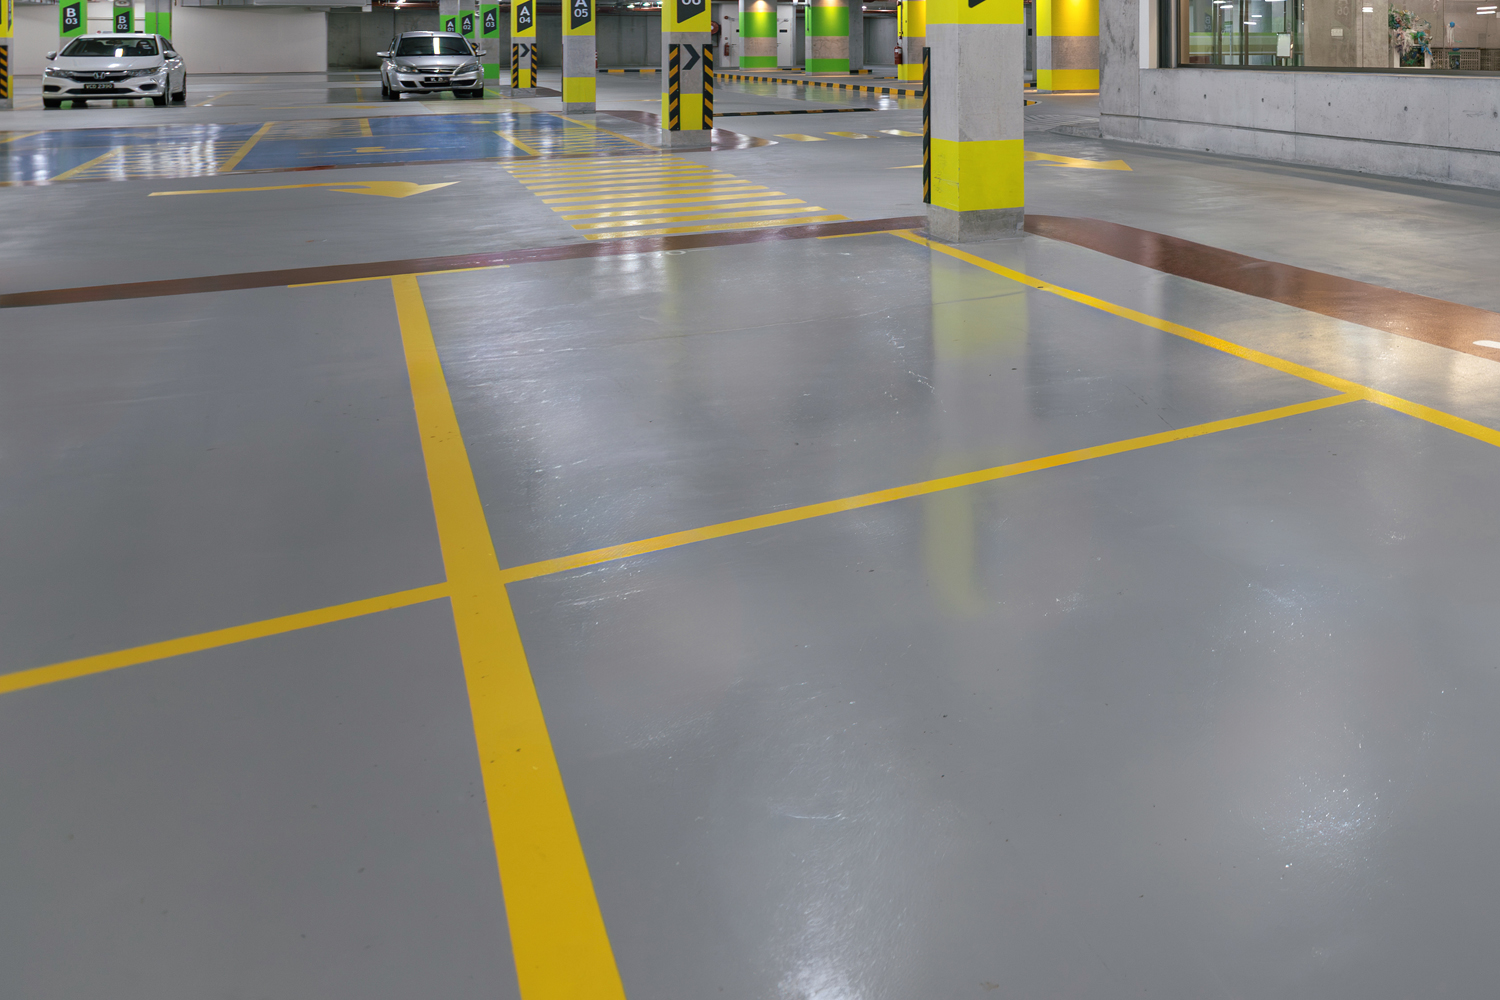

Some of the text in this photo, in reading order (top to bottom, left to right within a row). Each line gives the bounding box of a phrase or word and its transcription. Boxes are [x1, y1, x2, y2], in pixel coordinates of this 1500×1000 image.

[66, 7, 77, 18] B
[519, 5, 531, 16] A
[574, 8, 589, 18] 05
[118, 15, 127, 24] B
[463, 17, 471, 25] A
[485, 12, 495, 22] A
[519, 16, 531, 24] 04
